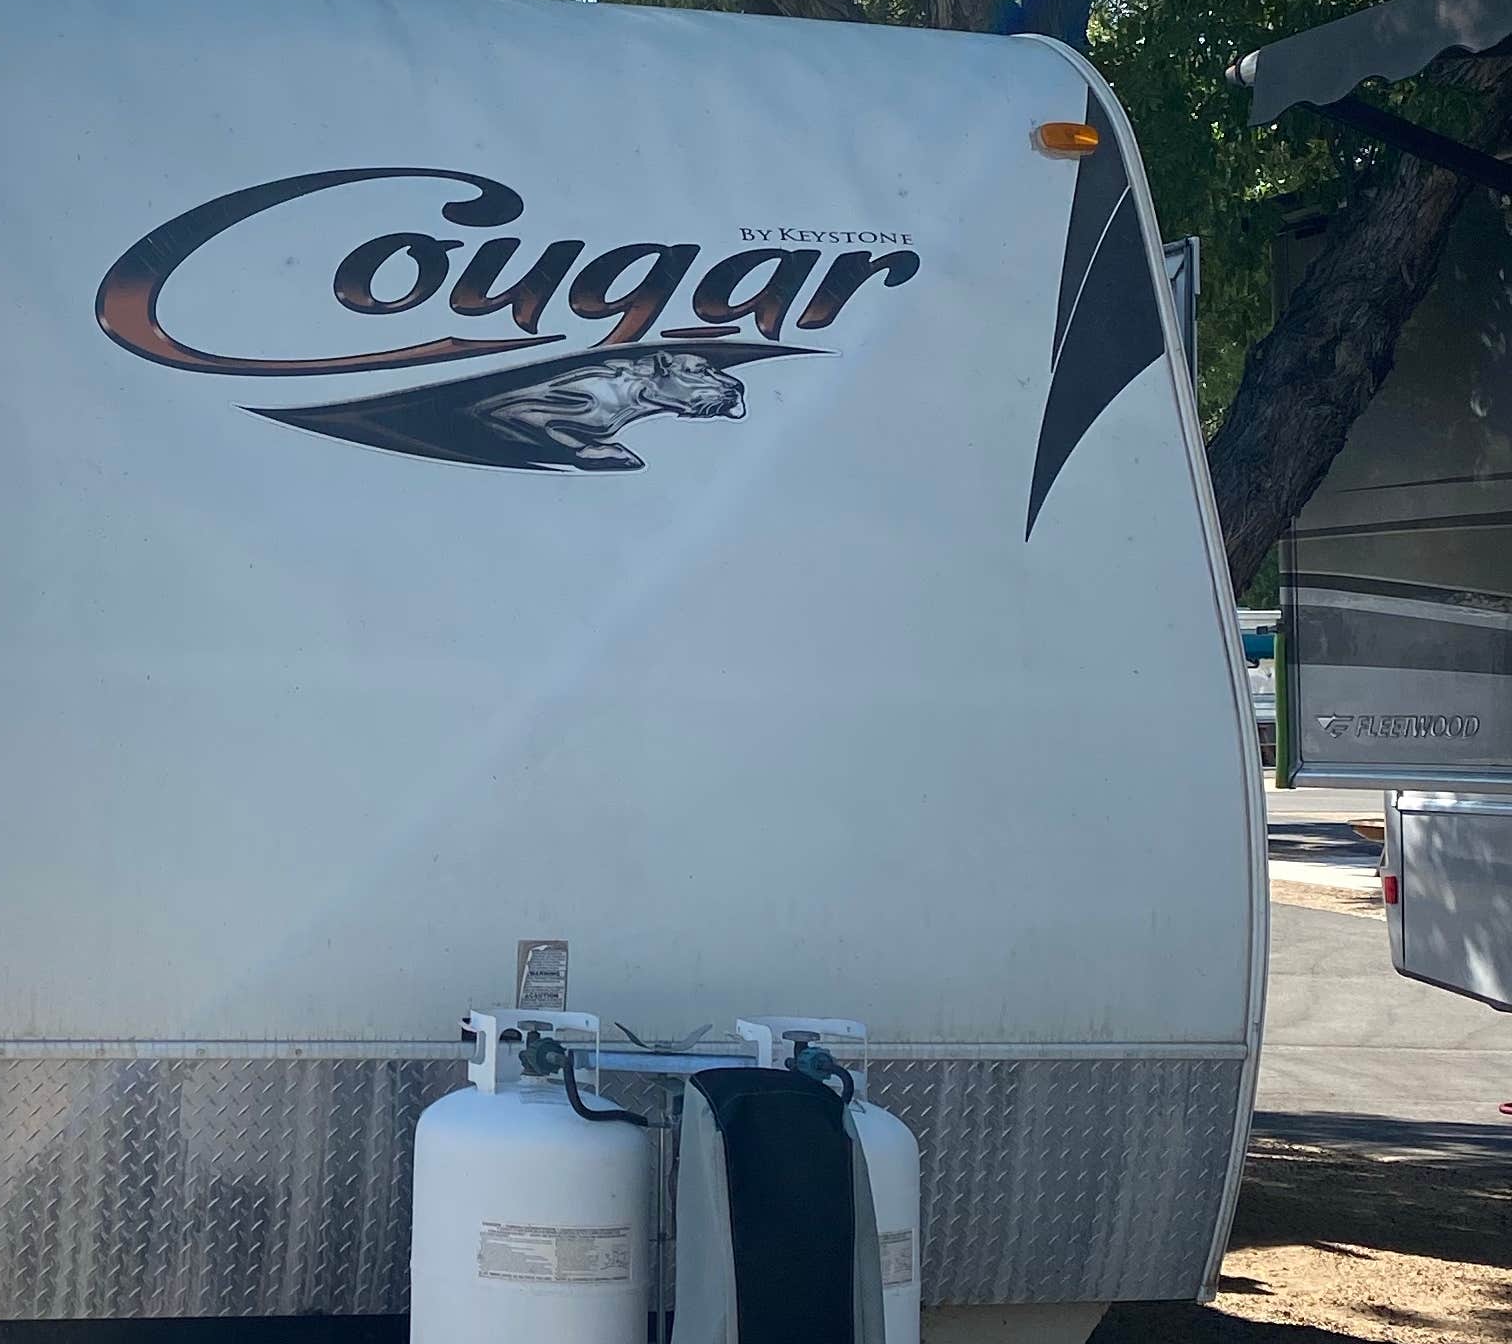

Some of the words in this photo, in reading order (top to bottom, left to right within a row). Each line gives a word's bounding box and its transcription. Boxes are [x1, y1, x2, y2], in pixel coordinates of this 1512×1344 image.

[738, 227, 773, 242] BY
[778, 227, 915, 246] KEYSTONE
[95, 167, 922, 377] Cougar
[1354, 714, 1480, 739] FLEETWOOD
